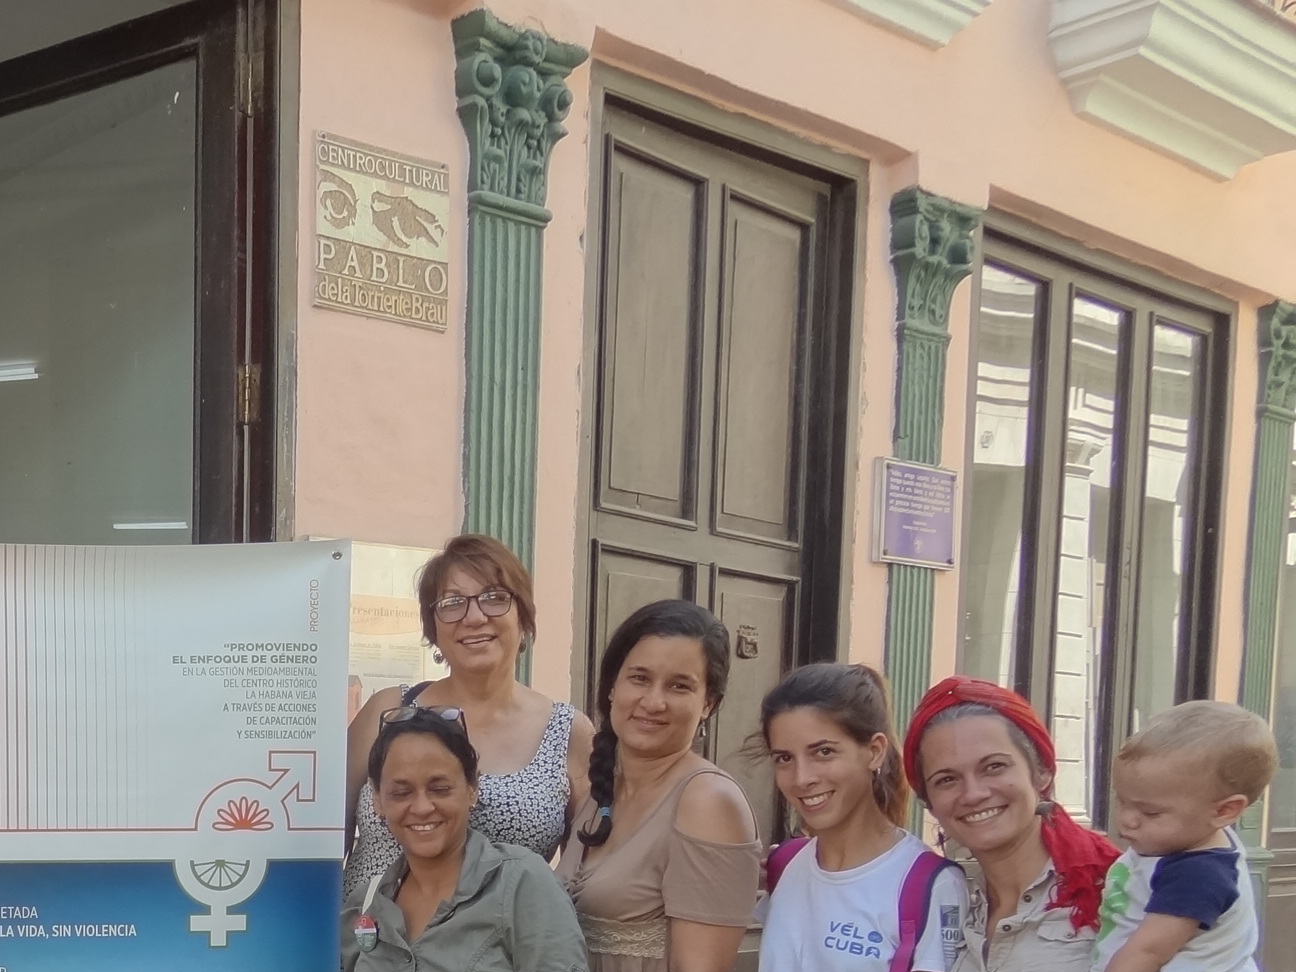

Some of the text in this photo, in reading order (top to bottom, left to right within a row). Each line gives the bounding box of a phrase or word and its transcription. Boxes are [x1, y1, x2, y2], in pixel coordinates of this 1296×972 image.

[318, 239, 447, 294] PABLO
[309, 579, 319, 632] PROYECTO
[351, 606, 420, 619] resentacione
[172, 653, 318, 665] EL ENFOQUE DE GÉNERO
[183, 666, 317, 676] EN LA GESTIÓN MEDIOAMBIENTAL
[223, 678, 318, 688] DEL CENTRO HISTÓRICO
[246, 691, 317, 700] LA HABANA VIEJA
[223, 702, 317, 712] A TRAVÉS DE ACCIONES
[246, 715, 317, 726] DE CAPACITACIÓN
[237, 730, 242, 739] Y
[0, 926, 14, 937] LA
[16, 925, 49, 940] VIDA,
[52, 924, 72, 937] SIN
[74, 924, 137, 937] VIOLENCIA
[824, 936, 881, 959] CUBA
